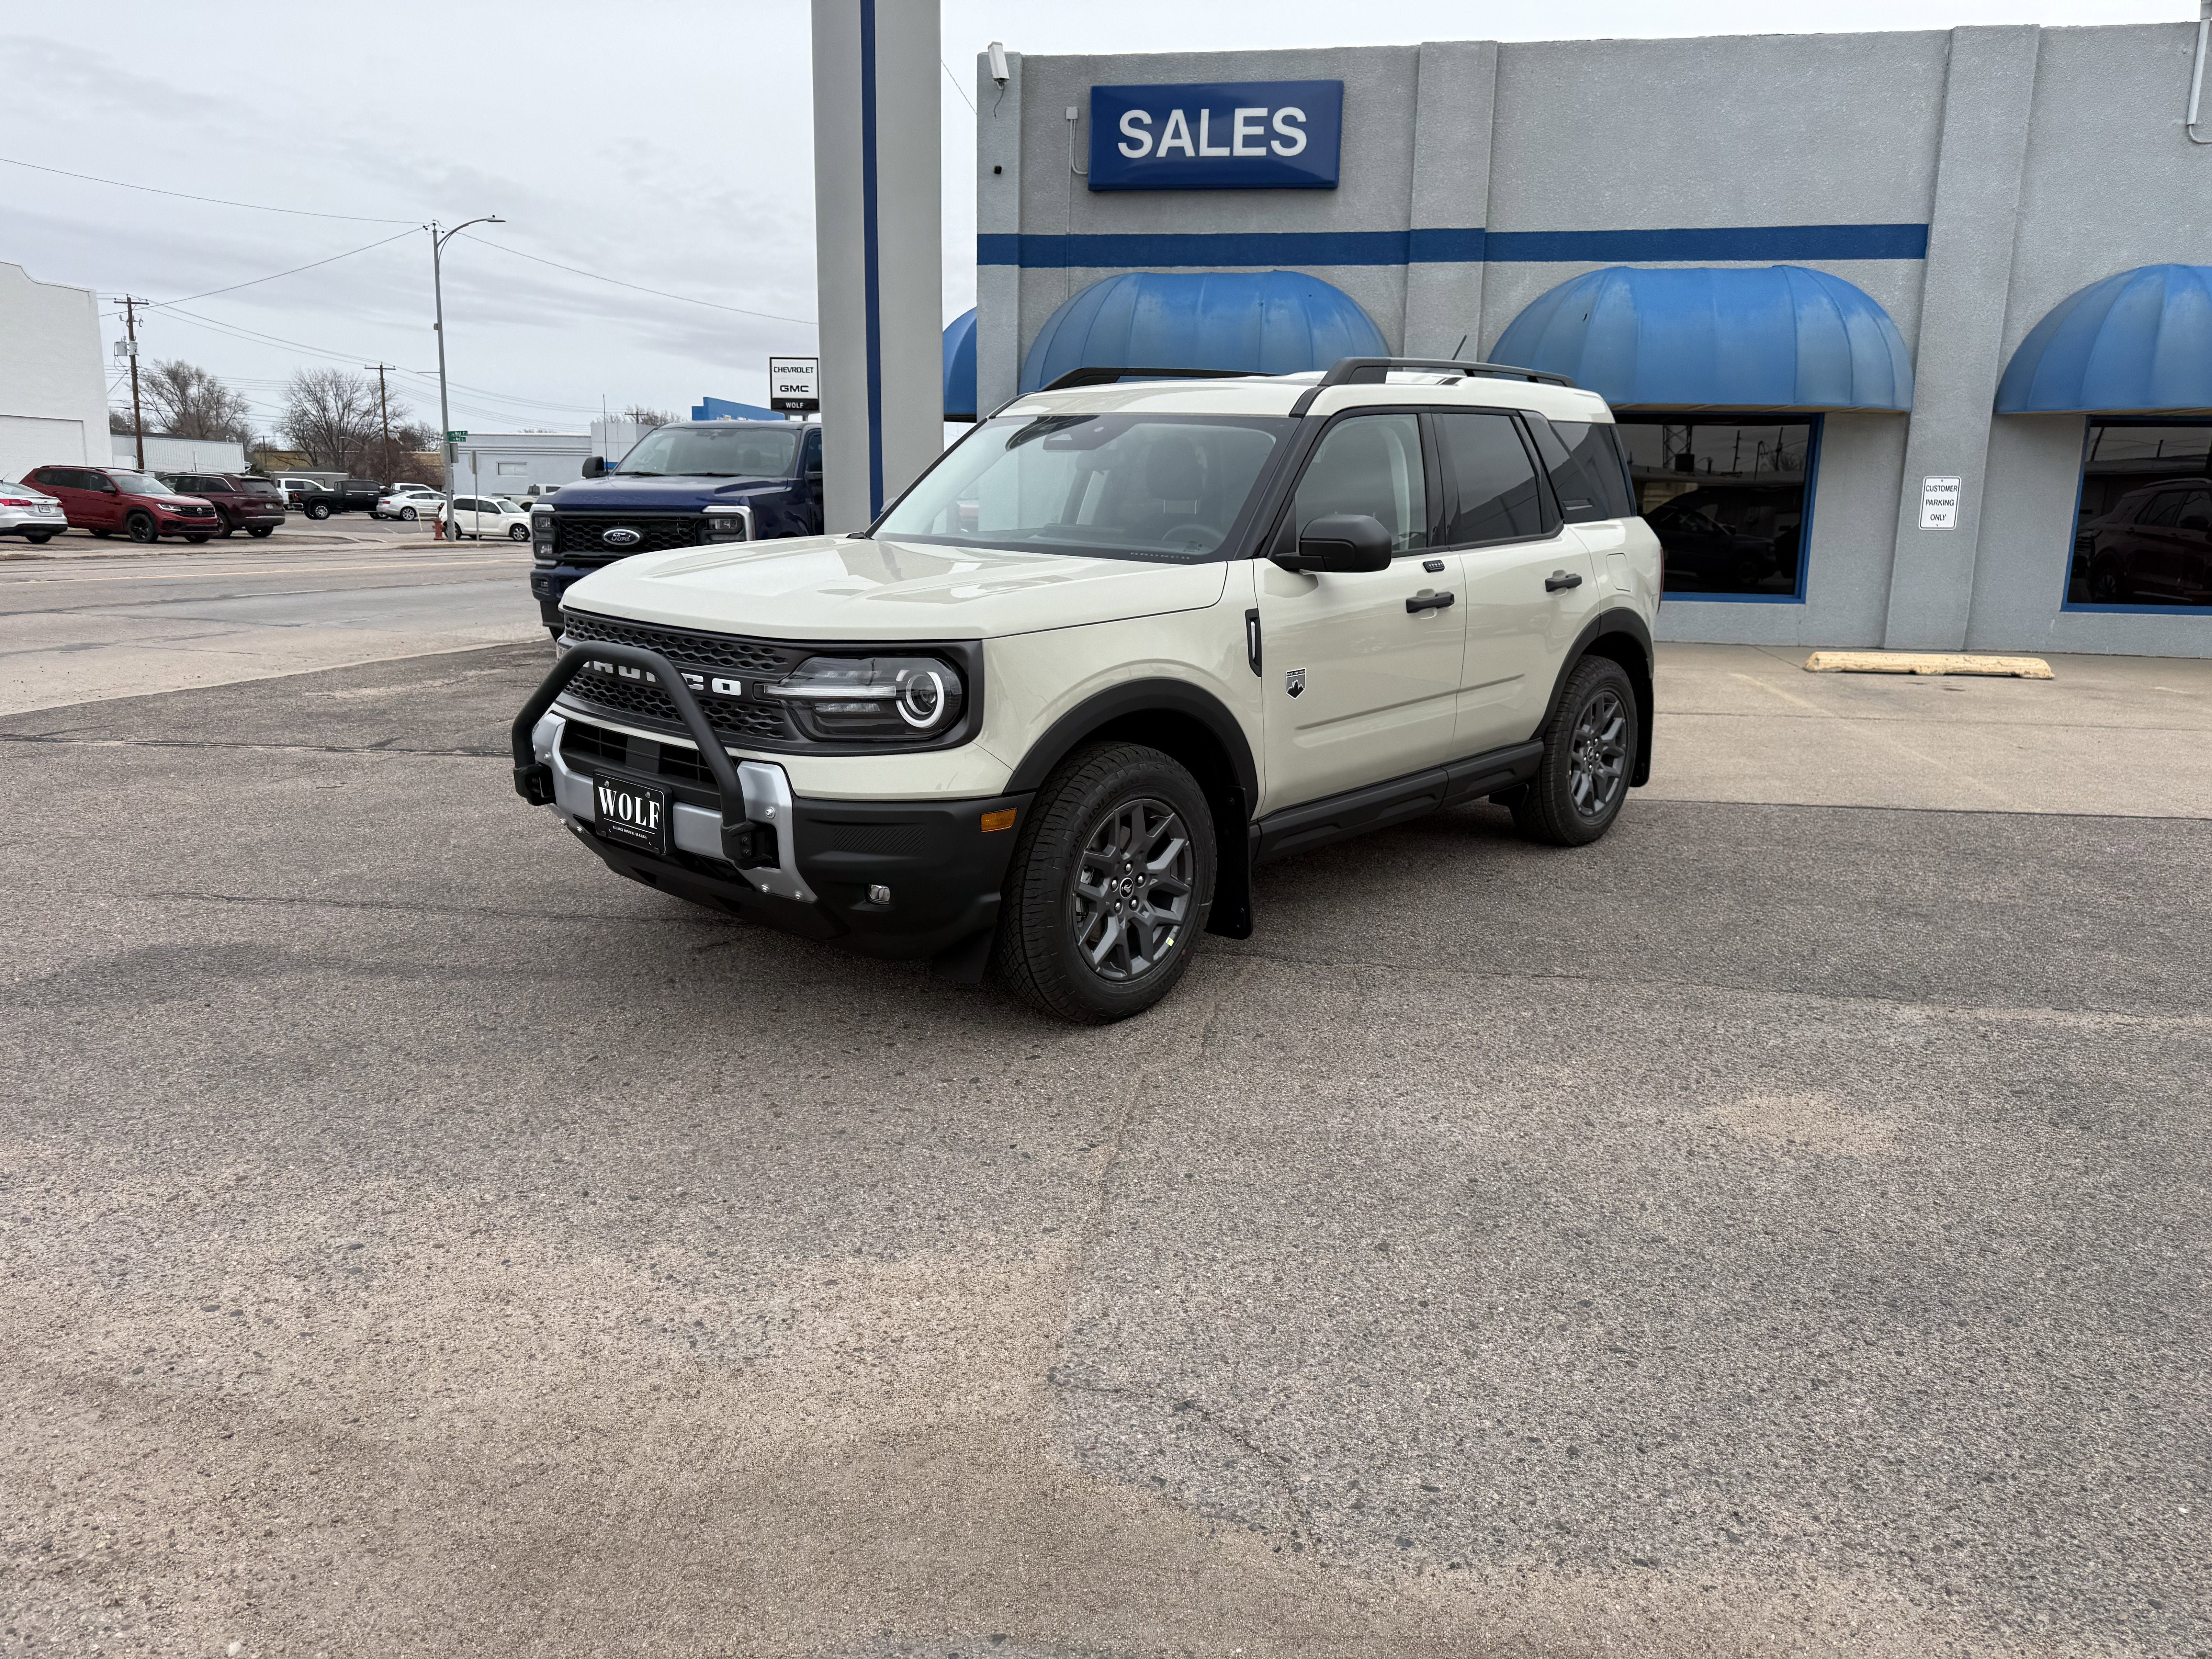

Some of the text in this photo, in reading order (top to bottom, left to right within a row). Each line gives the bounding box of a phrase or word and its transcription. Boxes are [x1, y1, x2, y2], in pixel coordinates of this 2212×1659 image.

[1118, 106, 1307, 158] SALES
[611, 532, 631, 541] Ford
[582, 660, 741, 696] ROCO
[598, 786, 660, 830] WOLF
